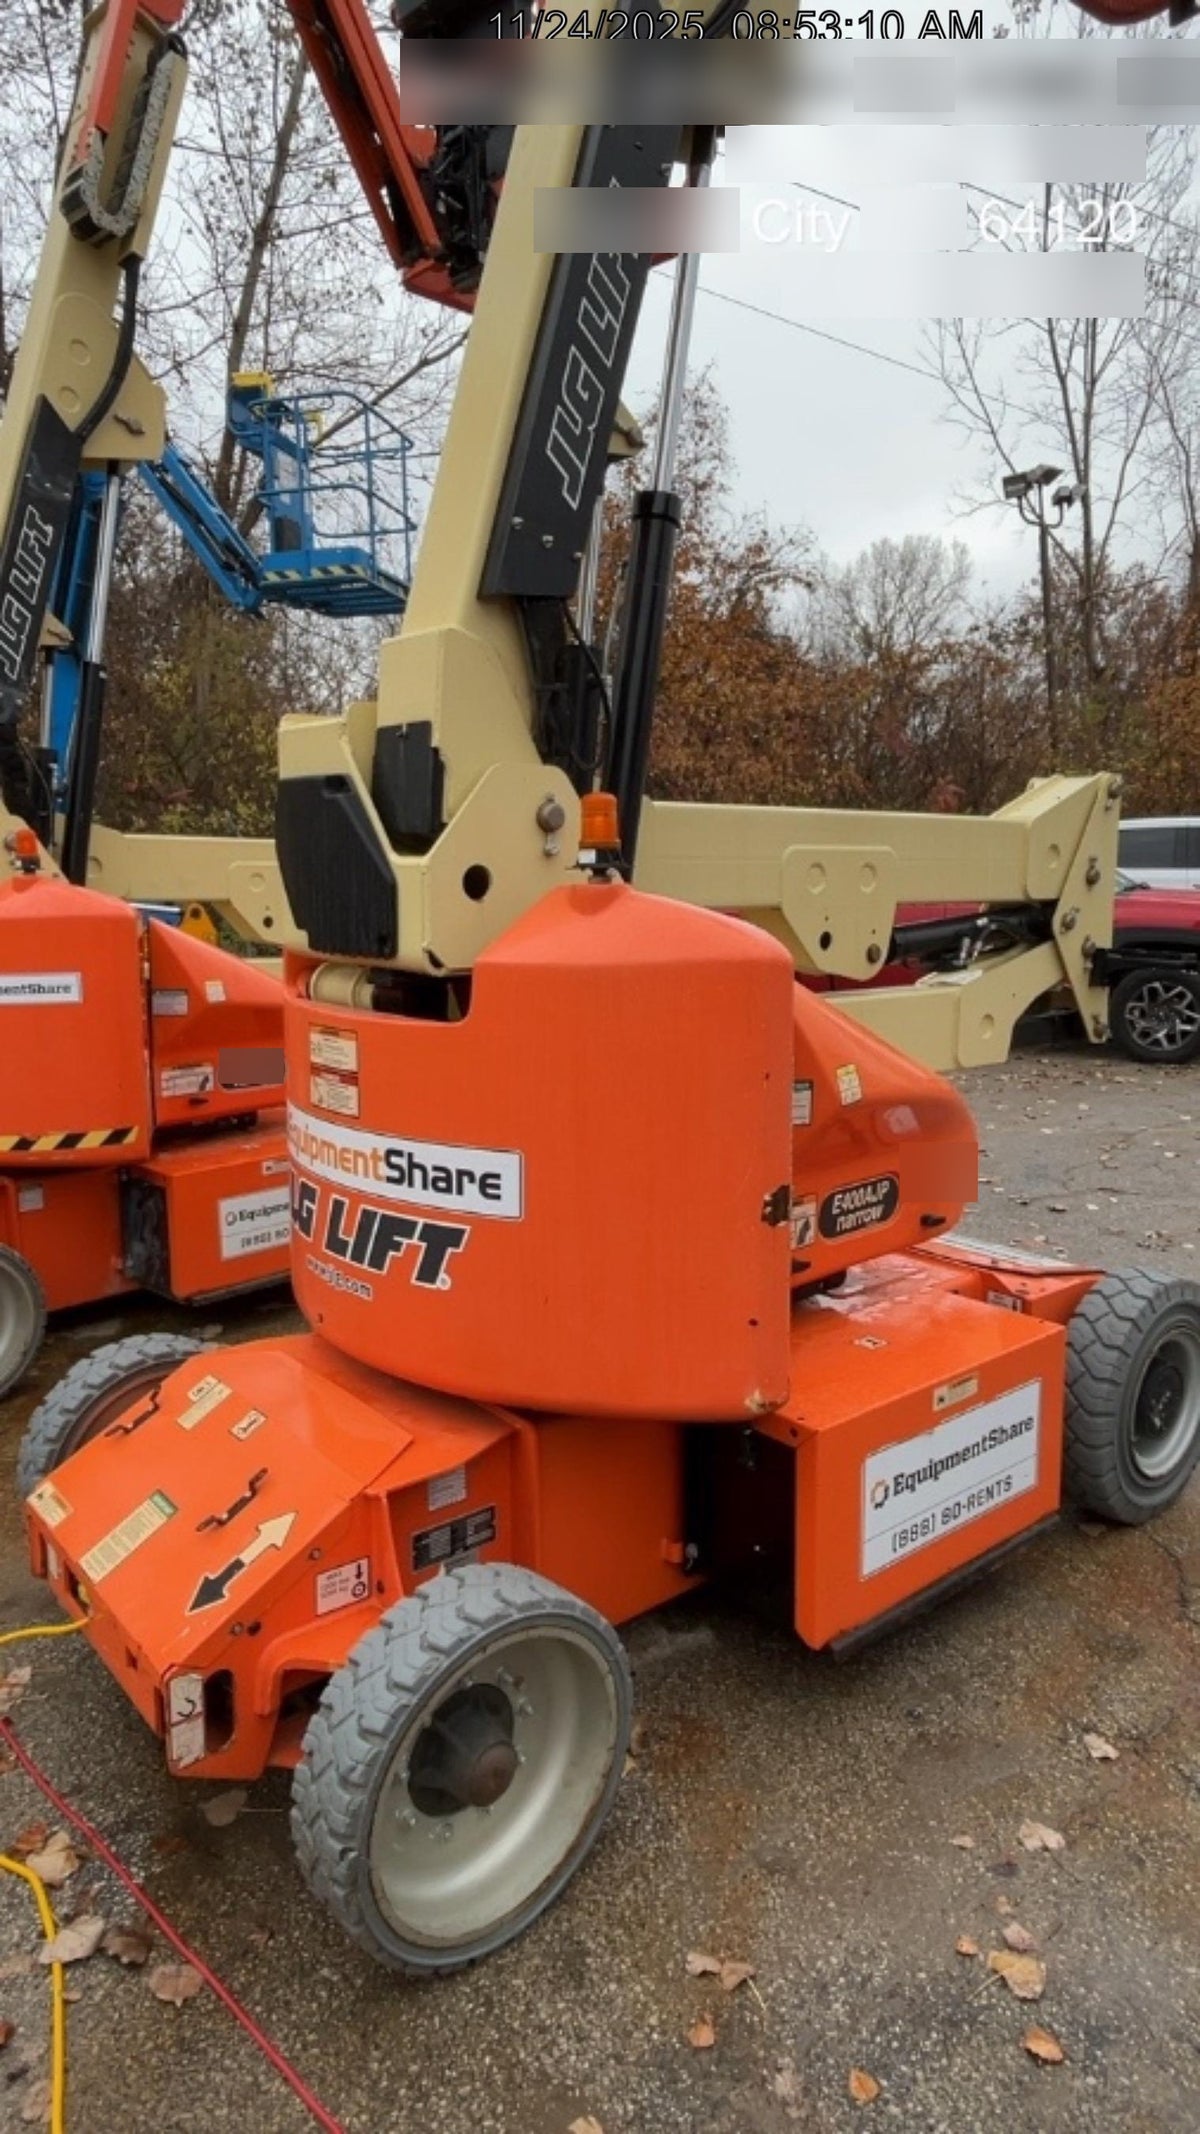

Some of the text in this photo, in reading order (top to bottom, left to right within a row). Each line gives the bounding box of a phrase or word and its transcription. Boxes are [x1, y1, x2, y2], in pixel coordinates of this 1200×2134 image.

[546, 344, 605, 512] JLG
[9, 504, 54, 606] LIFT
[892, 1415, 1035, 1496] EquipmentShare
